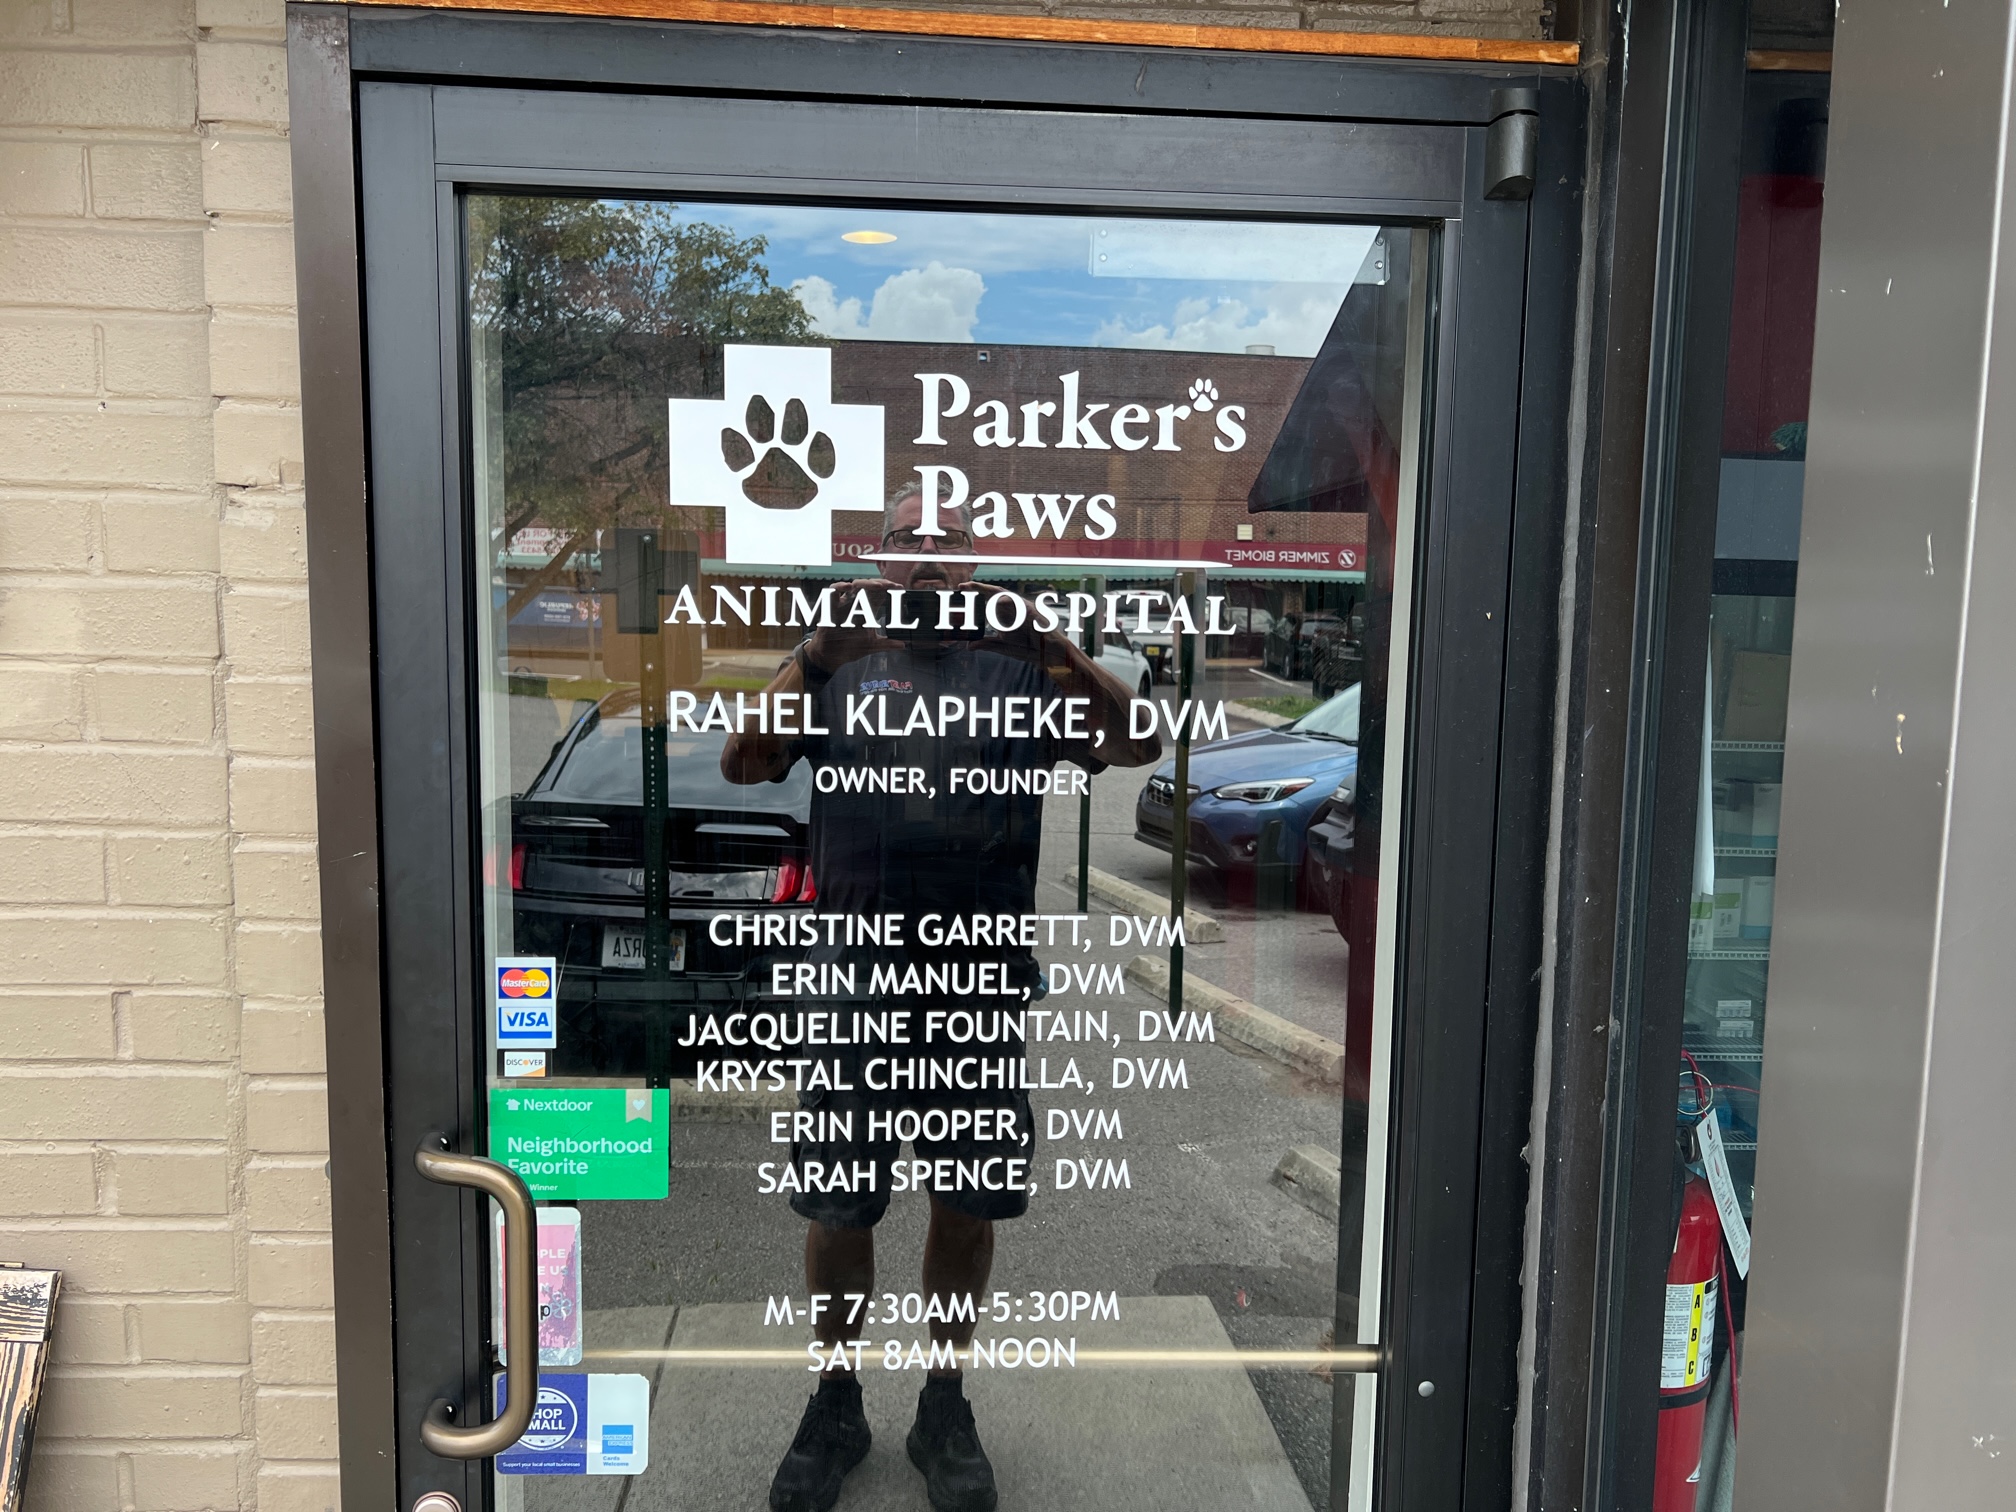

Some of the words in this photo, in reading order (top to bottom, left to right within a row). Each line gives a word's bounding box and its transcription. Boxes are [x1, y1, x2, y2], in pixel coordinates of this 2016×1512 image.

[912, 370, 1247, 453] Parker's
[911, 465, 1117, 541] Paws
[663, 584, 920, 629] ANIMAL
[934, 588, 1237, 636] HOSPITAL
[669, 690, 829, 735] RAHEL
[846, 694, 1105, 748] KLAPHEKE,
[1128, 698, 1230, 741] DVM
[815, 766, 937, 799] OWNER,
[949, 765, 1090, 796] FOUNDER
[708, 913, 905, 947] CHRISTINE
[917, 913, 1092, 953] GARRETT,
[1109, 914, 1187, 947] DVM
[501, 979, 549, 989] MasterCard
[771, 963, 855, 995] ERIN
[868, 962, 1031, 1002] MANUEL,
[1048, 963, 1126, 996] DVM
[505, 1011, 549, 1027] VISA
[677, 1011, 911, 1051] JACQUELINE
[924, 1010, 1121, 1049] FOUNTAIN,
[1138, 1010, 1216, 1043] DVM
[696, 1060, 854, 1093] KRYSTAL
[864, 1057, 1095, 1096] CHINCHILLA,
[1112, 1057, 1190, 1090] DVM
[523, 1098, 593, 1111] Nextdoor
[770, 1110, 853, 1143] ERIN
[867, 1108, 1030, 1147] HOOPER,
[1046, 1108, 1124, 1140] DVM
[507, 1136, 653, 1157] Neighborhood
[529, 1183, 558, 1192] Winner
[757, 1160, 877, 1194] SARAH
[890, 1157, 1038, 1197] SPENCE,
[1055, 1158, 1132, 1191] DVM
[540, 1248, 566, 1259] PLE
[763, 1295, 832, 1326] M-F
[843, 1290, 1121, 1325] 7:30AM-5:30PM
[1694, 1294, 1701, 1309] A
[1690, 1327, 1698, 1342] B
[807, 1340, 871, 1372] SAT
[883, 1337, 1076, 1371] 8AM-NOON
[1688, 1360, 1695, 1375] C
[528, 1419, 566, 1431] MALL
[534, 1408, 563, 1419] HOP
